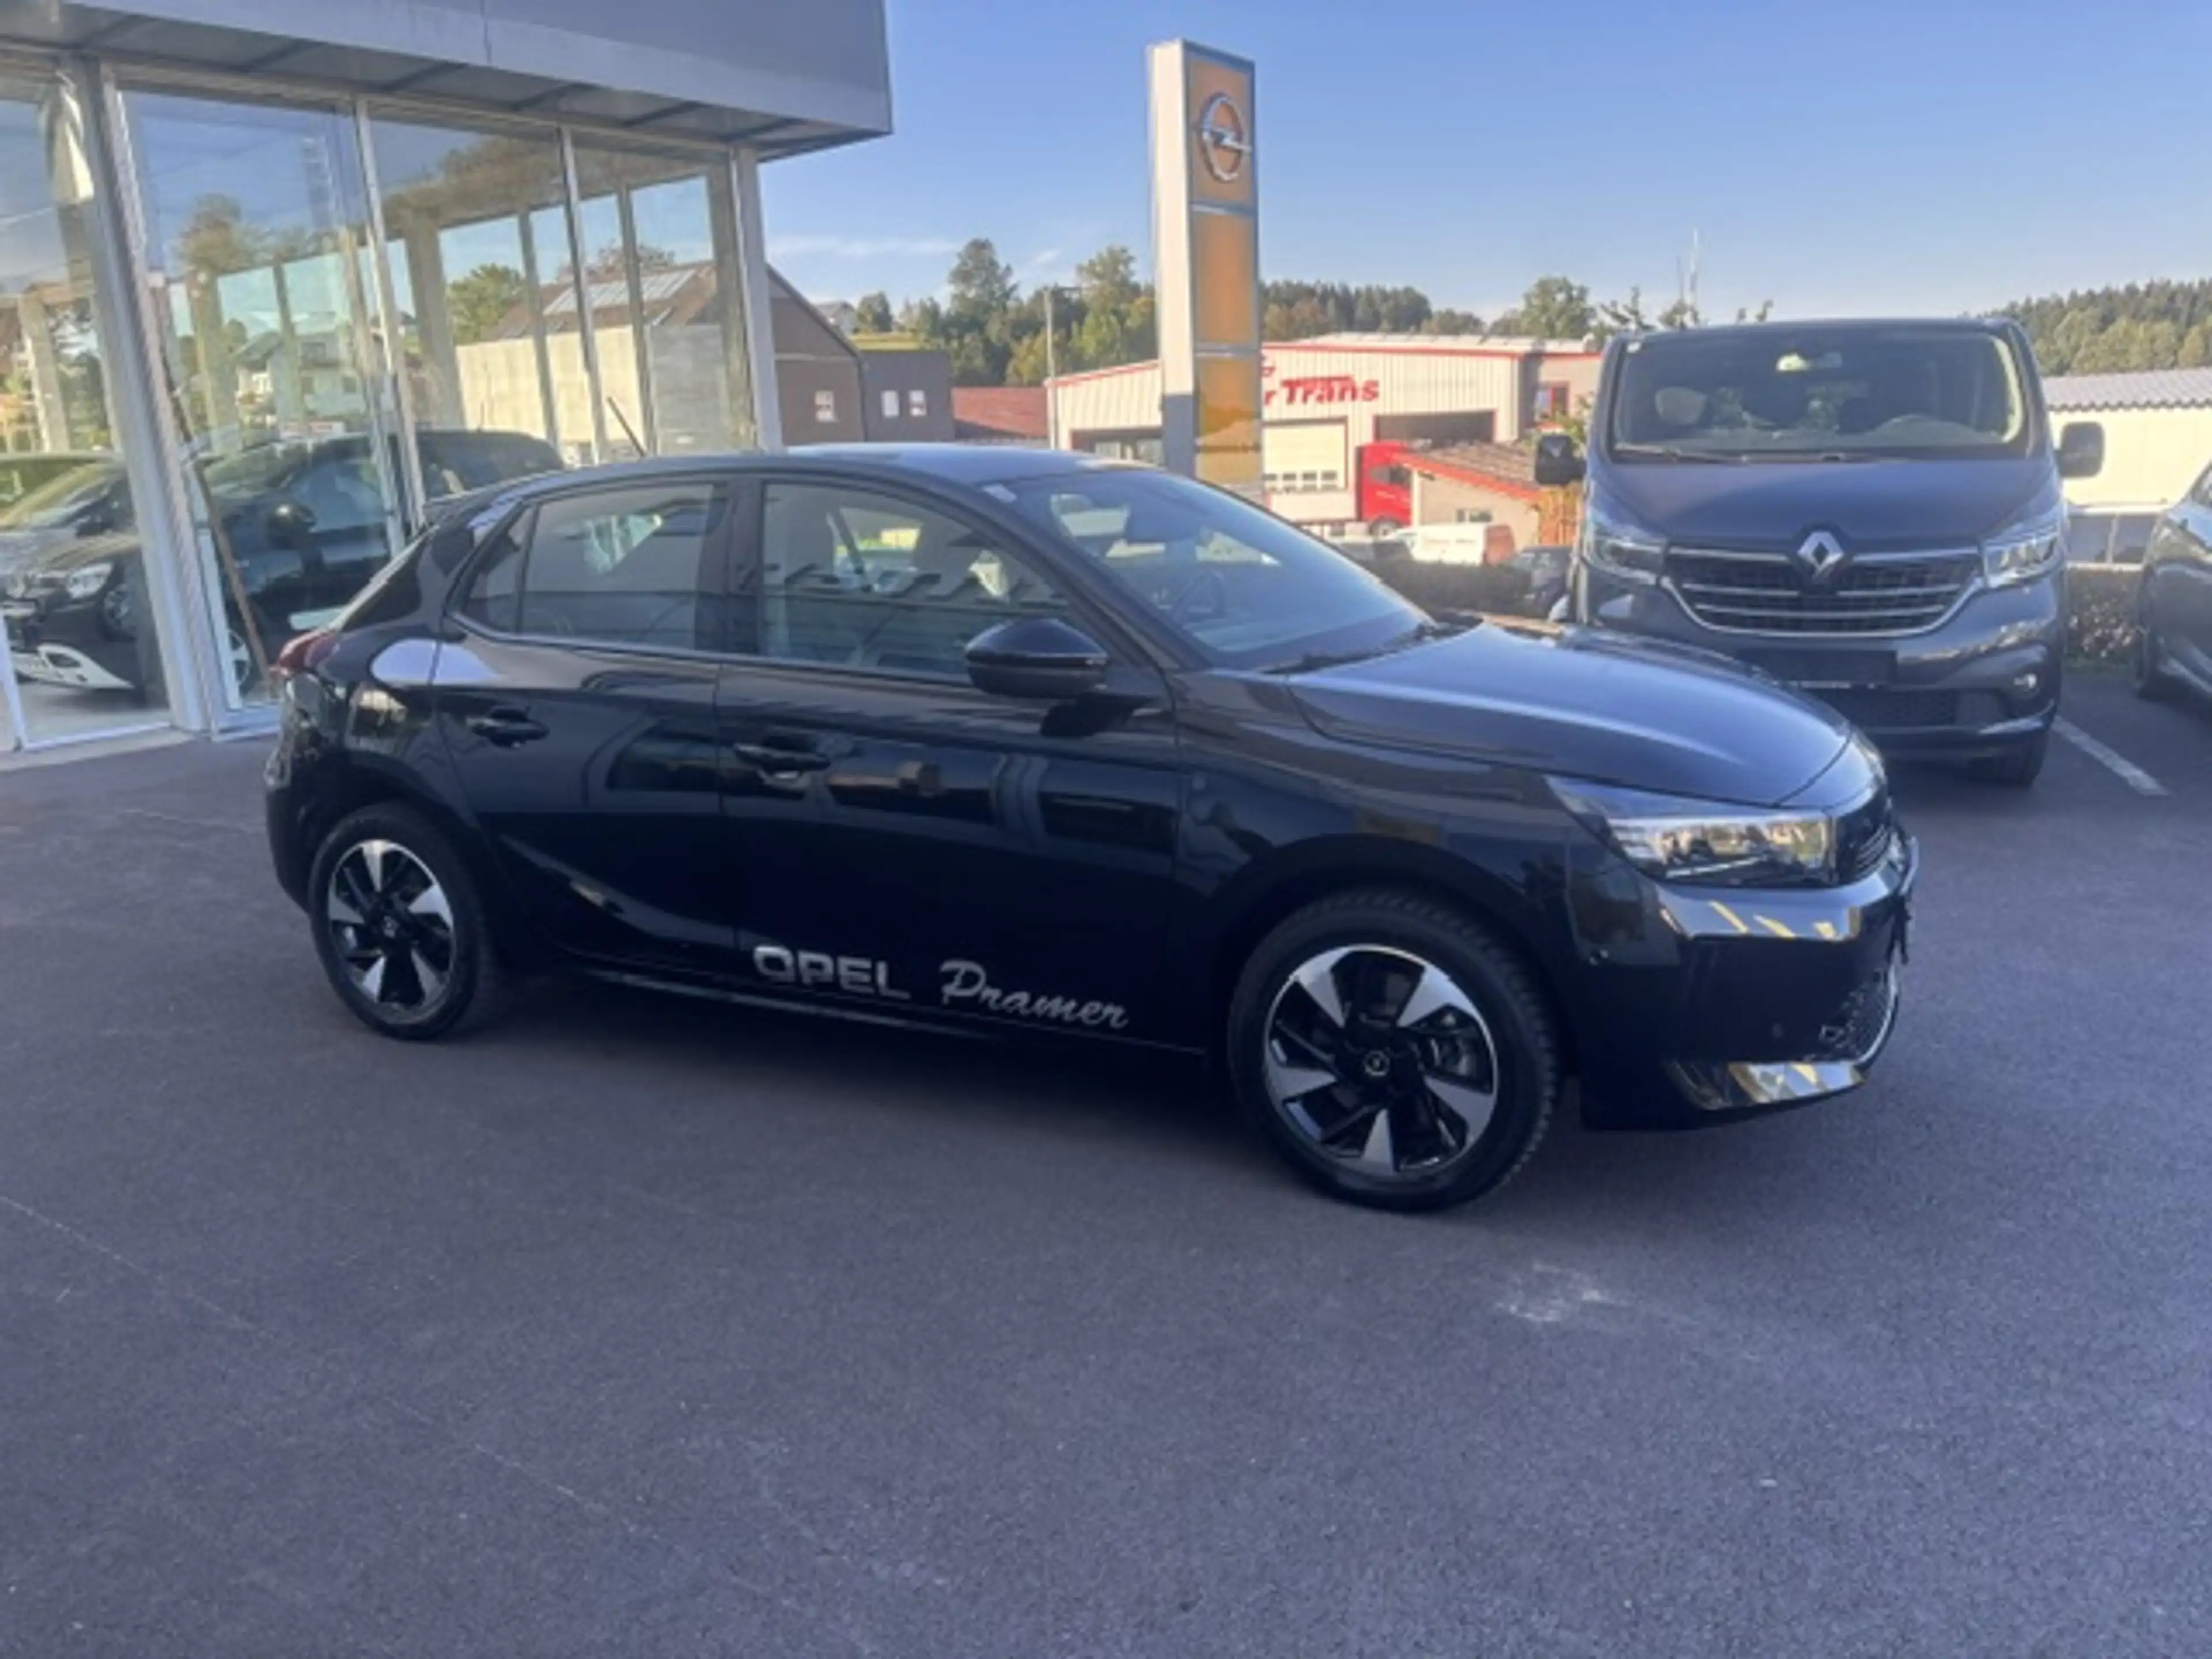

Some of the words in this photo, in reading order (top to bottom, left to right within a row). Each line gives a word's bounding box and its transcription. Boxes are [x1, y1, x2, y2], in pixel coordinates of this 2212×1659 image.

[1281, 376, 1380, 404] Trans
[753, 945, 911, 999] OPEL
[940, 960, 1129, 1029] Pramer
